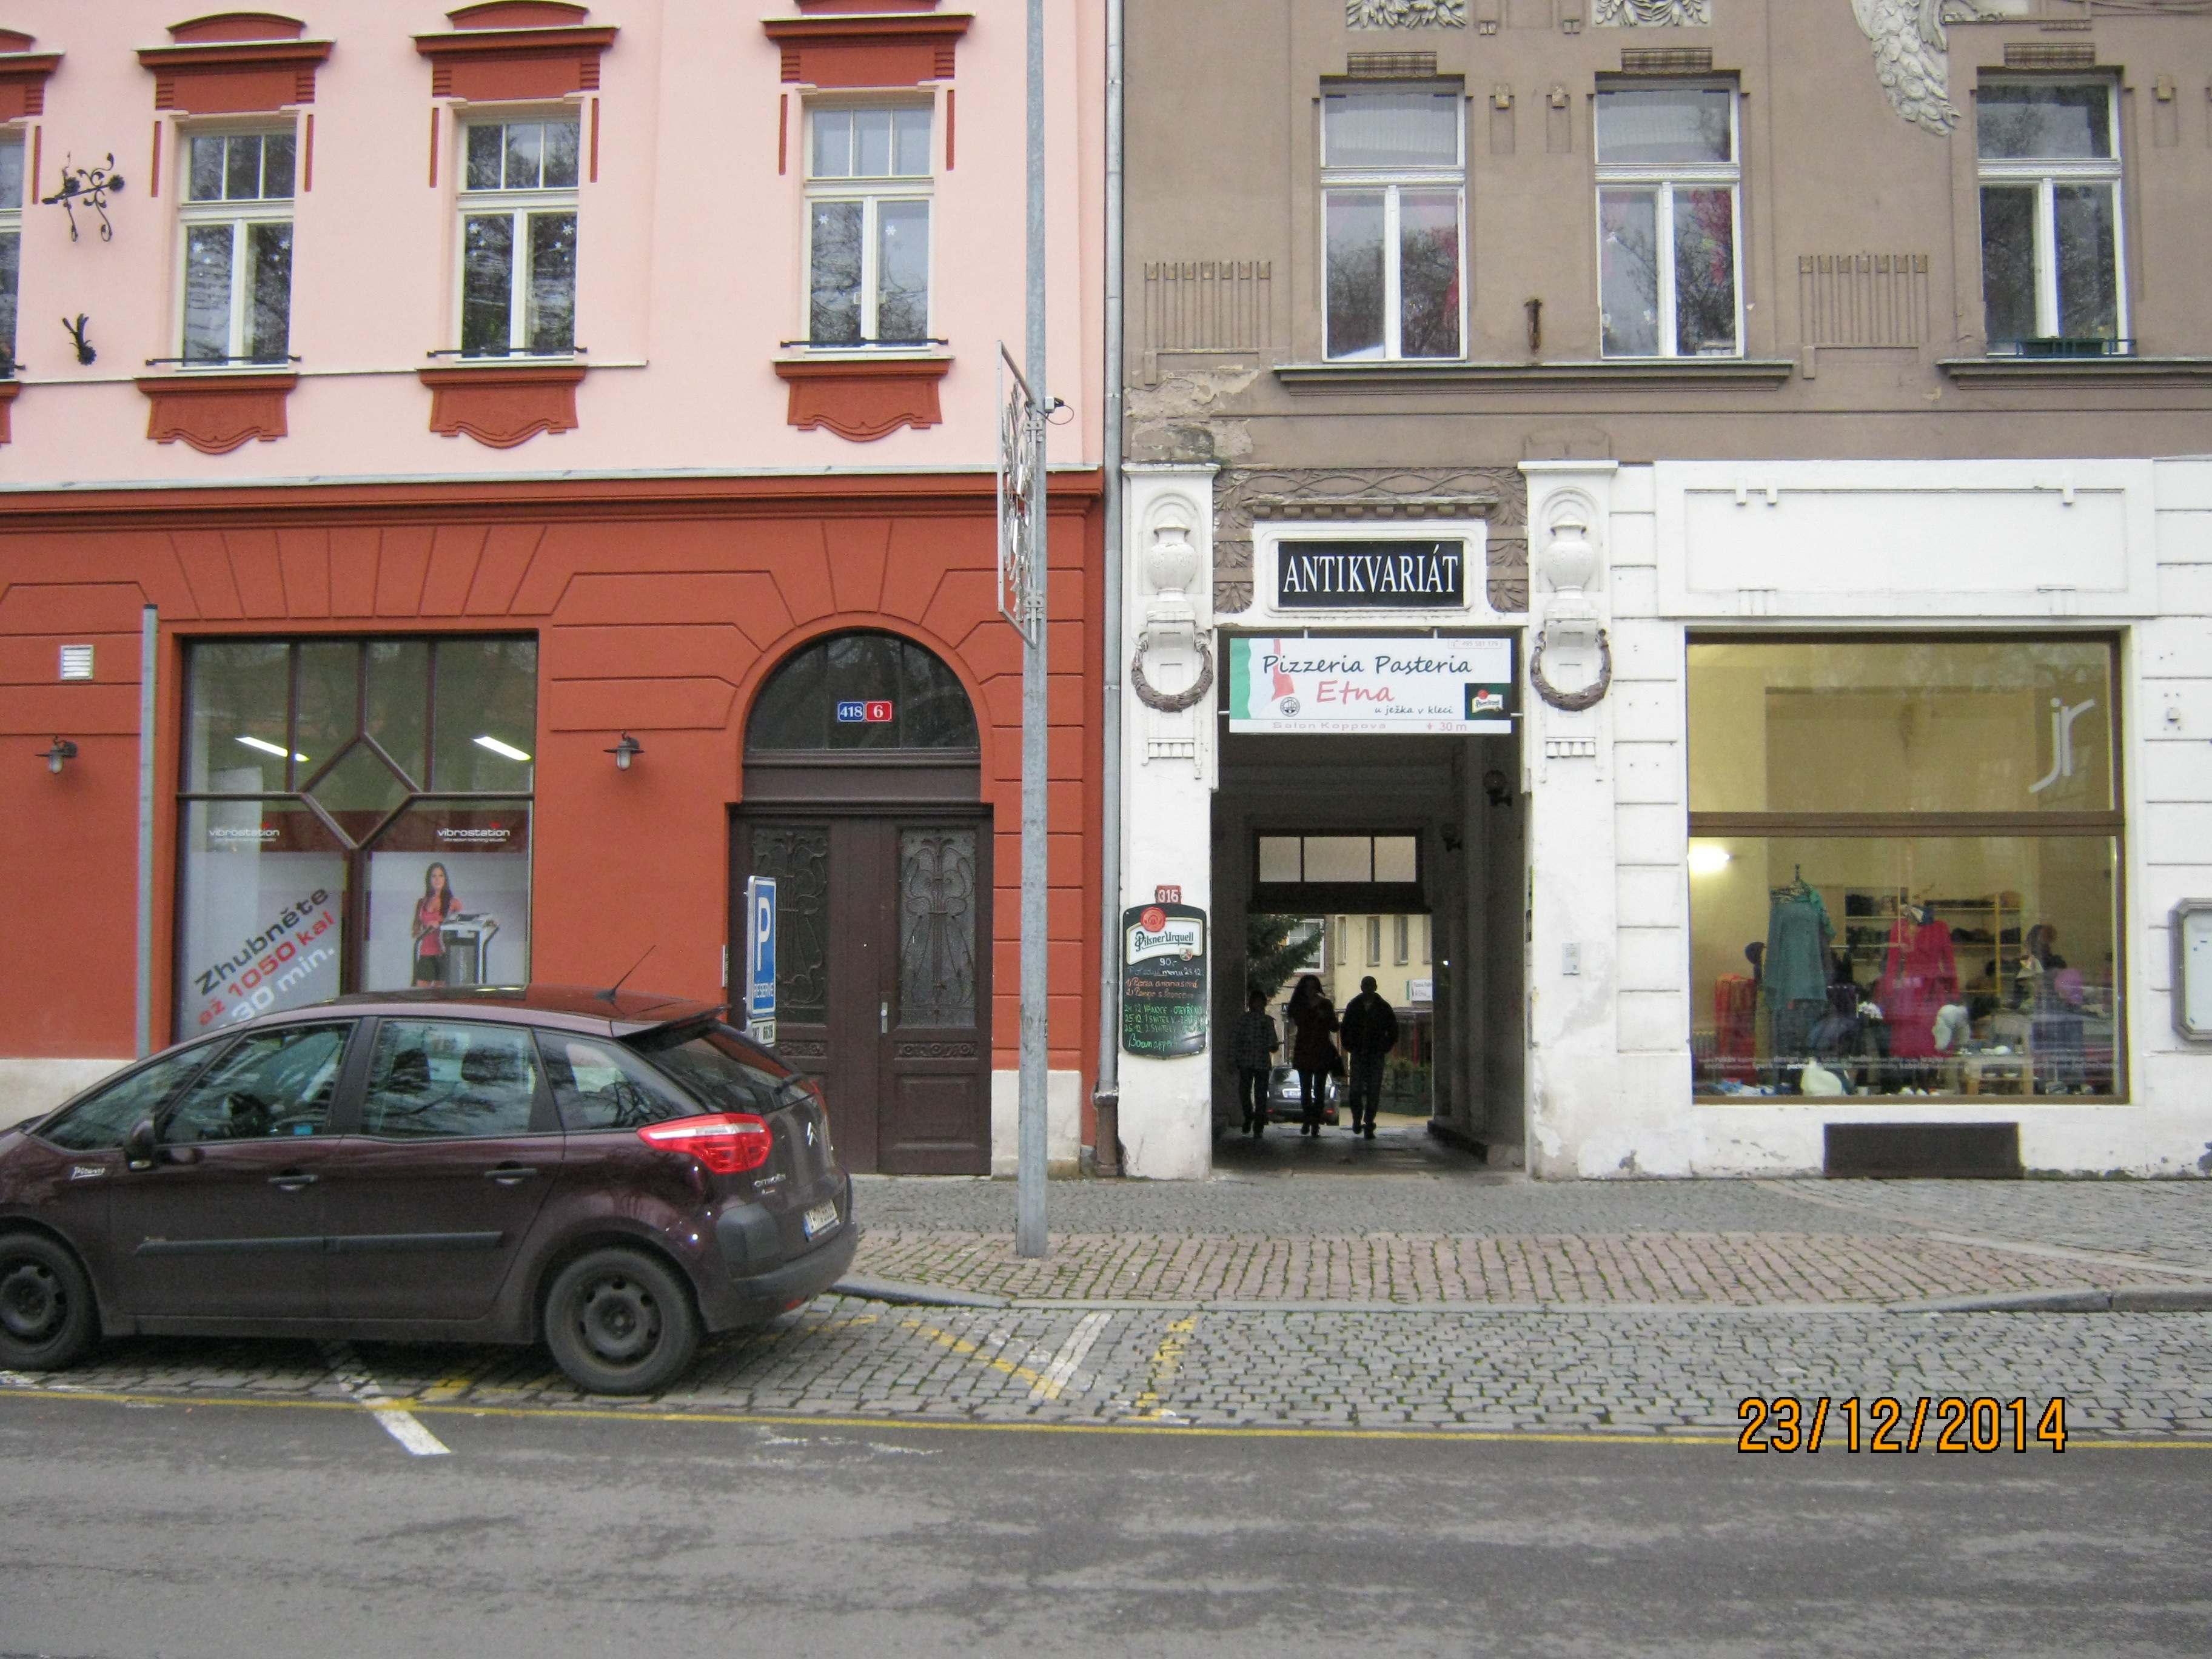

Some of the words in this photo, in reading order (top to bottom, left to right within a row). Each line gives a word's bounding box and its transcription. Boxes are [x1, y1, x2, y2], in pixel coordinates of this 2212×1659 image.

[1282, 543, 1458, 593] ANTIKVARIÁT
[1262, 655, 1364, 674] Pizzeria
[1375, 655, 1472, 675] Pasteria
[1316, 680, 1395, 705] Etna
[840, 706, 863, 717] 418
[873, 705, 883, 718] 6
[1384, 705, 1413, 716] ježka
[1428, 705, 1453, 714] kleci
[1321, 722, 1386, 731] Koppova
[1439, 722, 1452, 731] 30
[437, 828, 511, 836] vibrostation
[194, 889, 328, 996] Zhubněte
[1135, 931, 1165, 952] Pilsner
[1165, 930, 1194, 946] Urquell
[199, 996, 226, 1026] až
[228, 941, 297, 997] 1050
[296, 910, 335, 946] kal
[230, 985, 275, 1023] 30
[277, 948, 335, 992] min.
